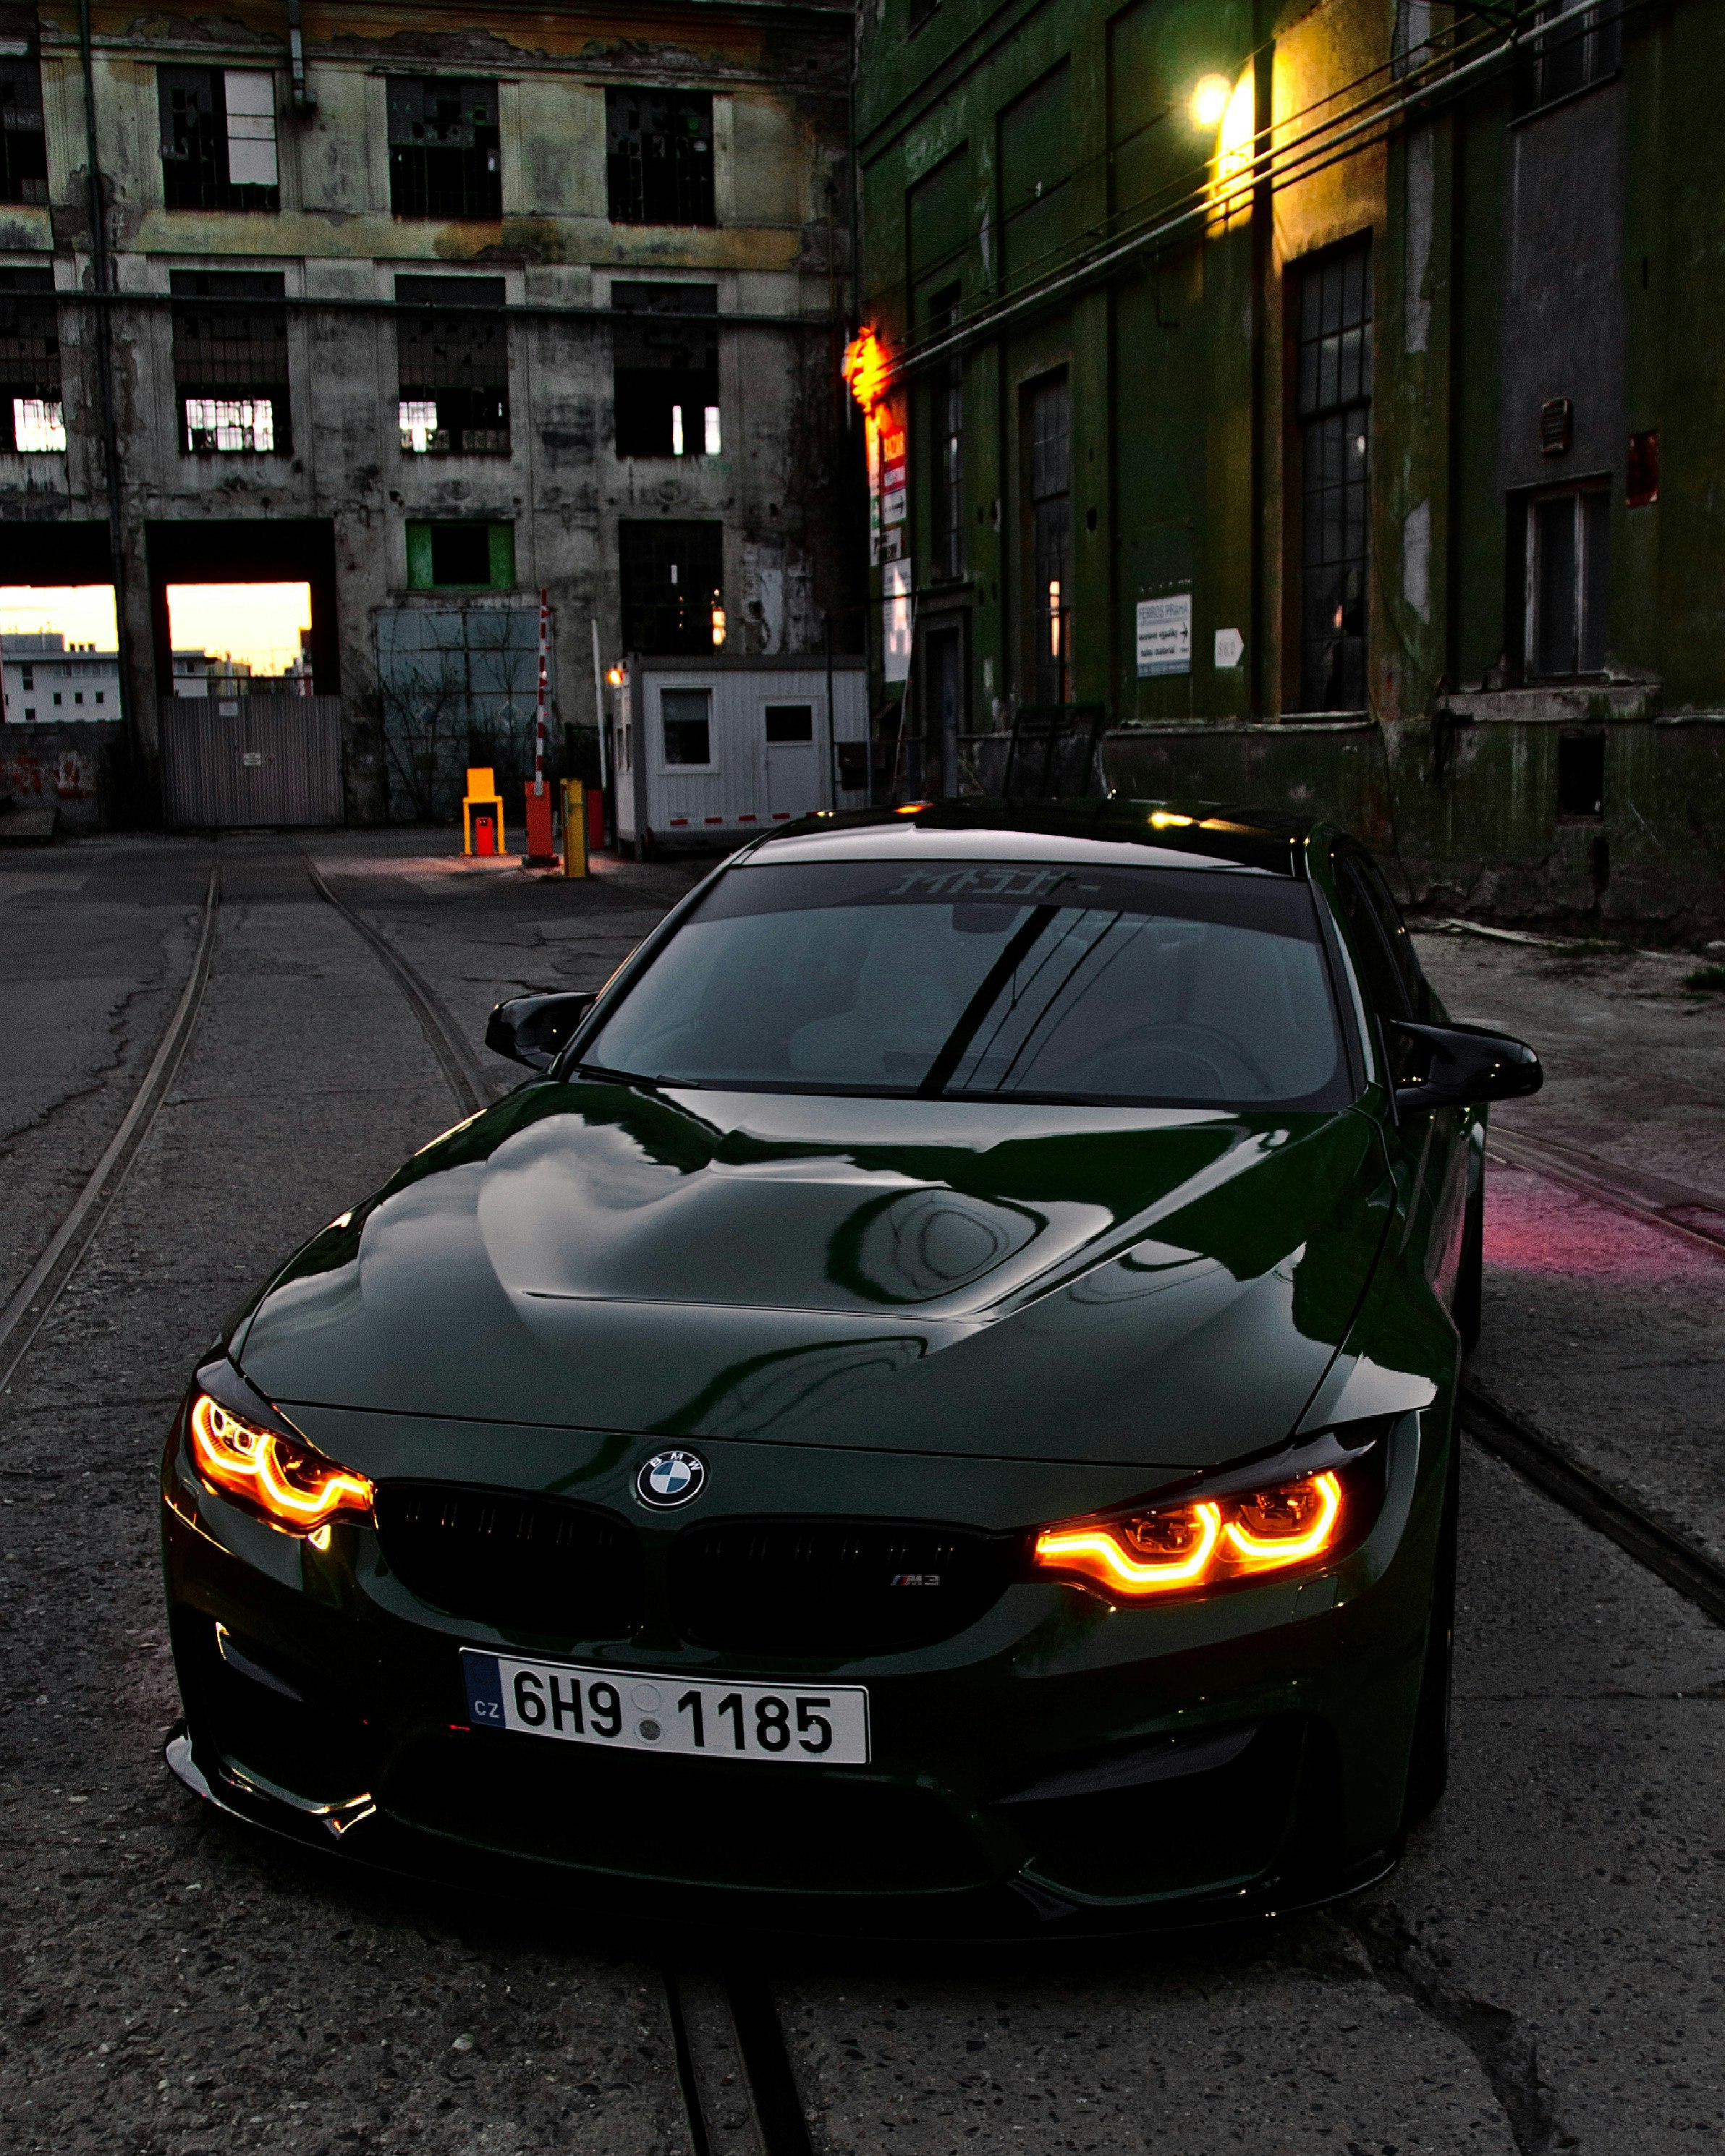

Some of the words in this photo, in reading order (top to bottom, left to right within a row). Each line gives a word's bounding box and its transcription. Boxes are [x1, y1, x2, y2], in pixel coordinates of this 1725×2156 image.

[649, 1452, 701, 1470] BMW
[903, 1574, 940, 1586] M3
[474, 1699, 500, 1718] CZ
[512, 1670, 622, 1739] 6H9
[677, 1690, 834, 1754] 1185
